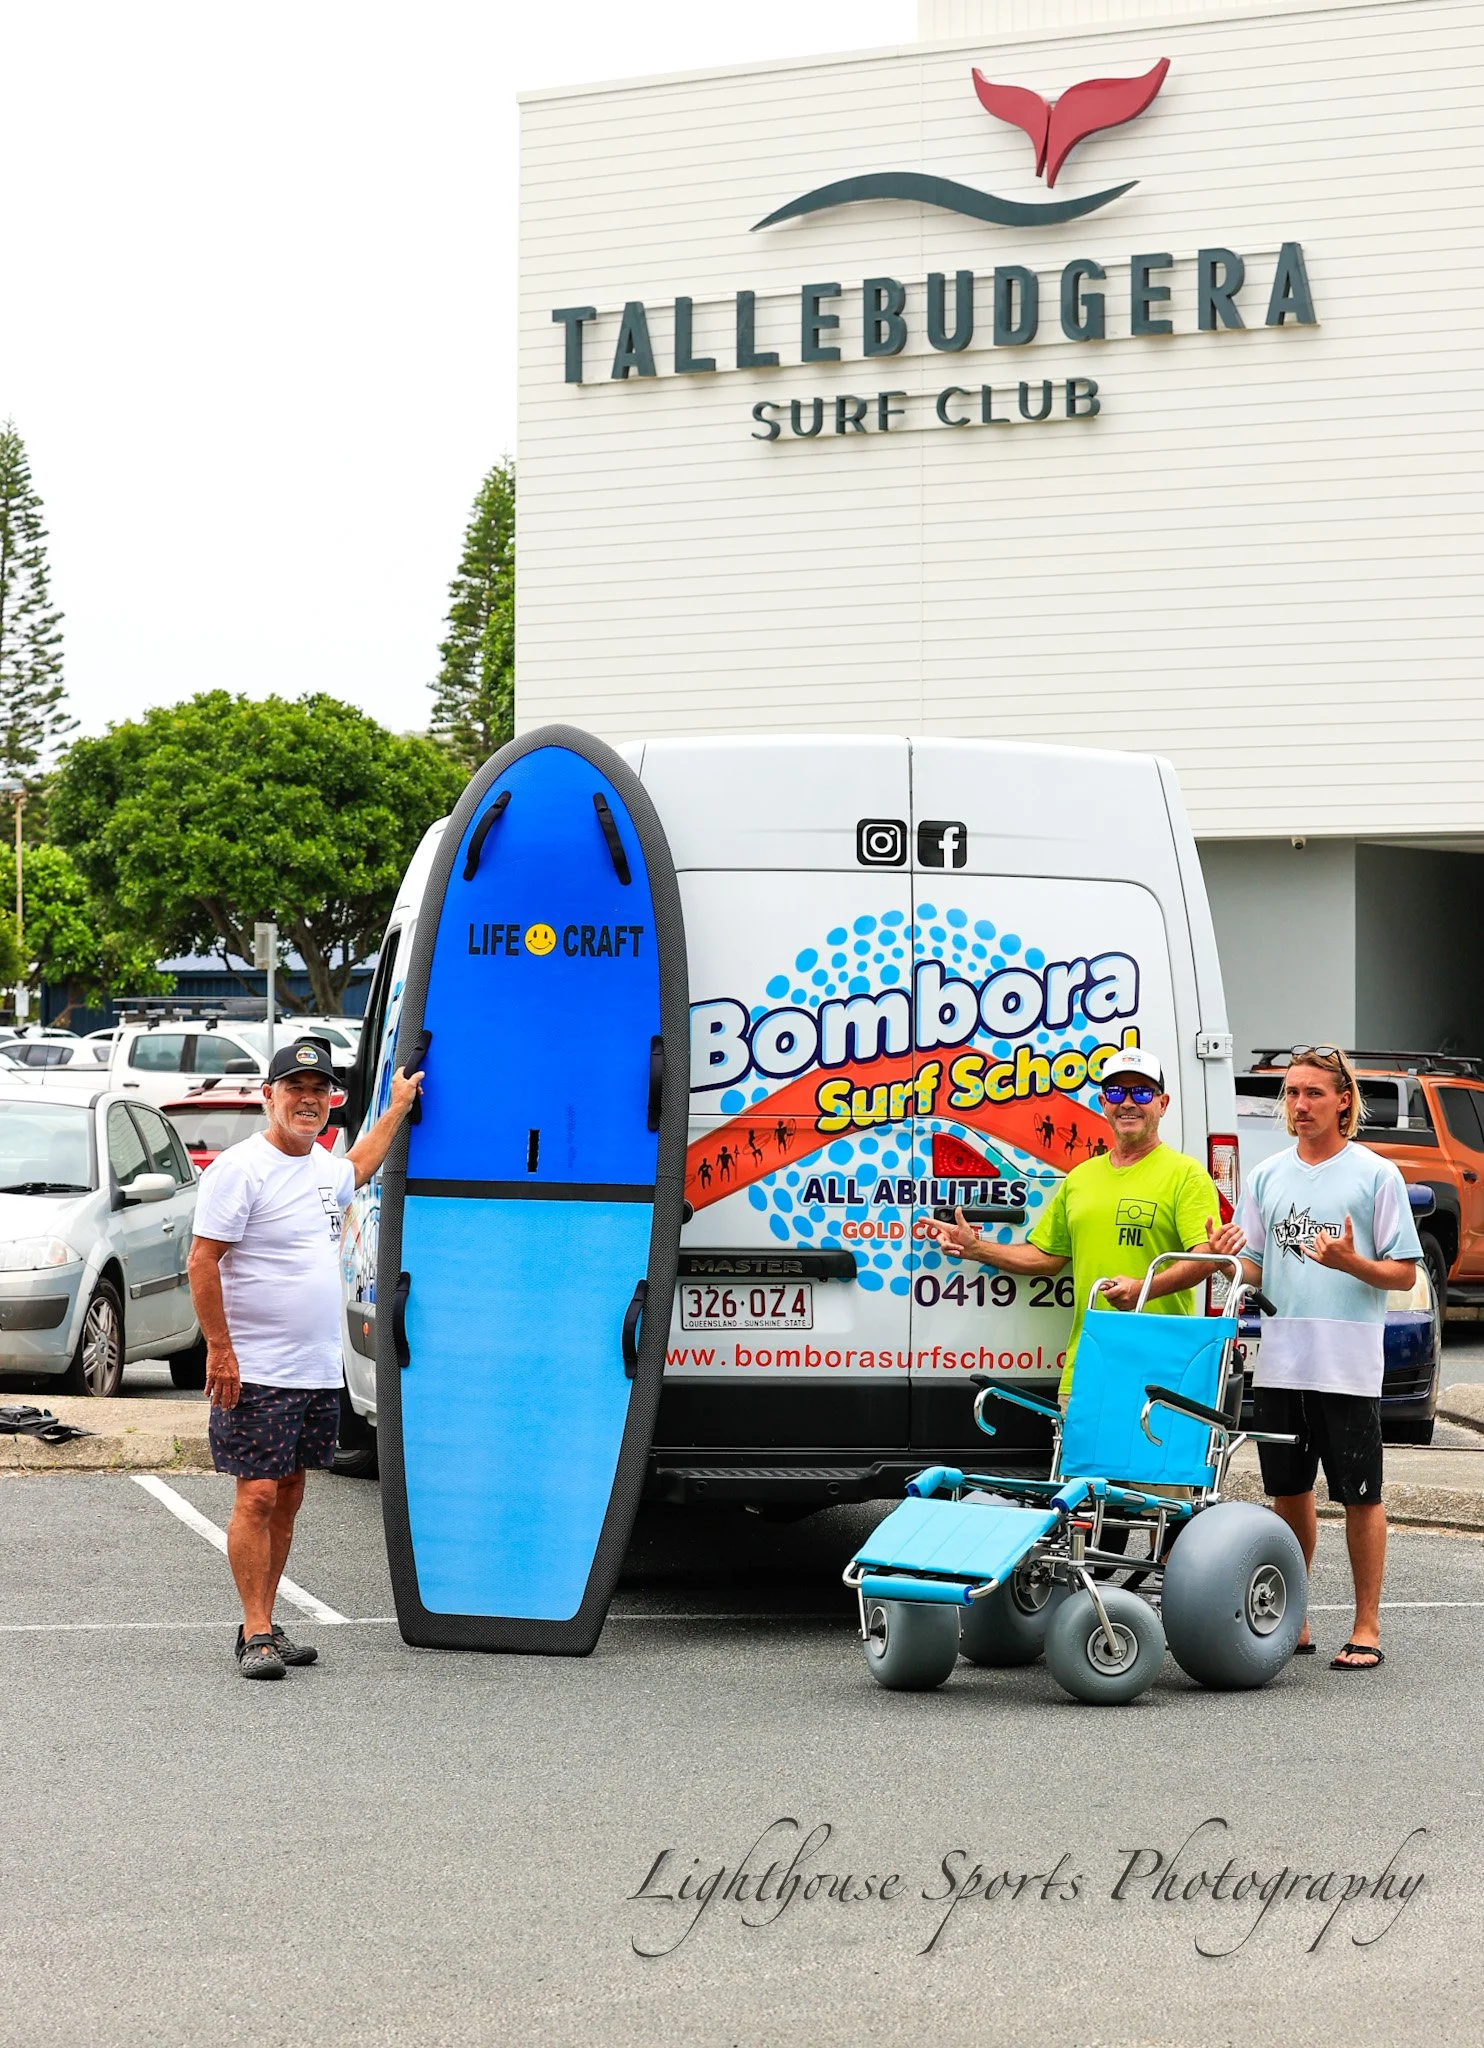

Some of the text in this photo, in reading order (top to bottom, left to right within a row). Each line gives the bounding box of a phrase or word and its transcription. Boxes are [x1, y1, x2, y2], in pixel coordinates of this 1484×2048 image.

[551, 241, 1320, 385] TALLEBUDGERA
[750, 376, 1101, 441] SURF CLUB
[468, 922, 645, 957] LIFE CRAFT
[690, 950, 1140, 1093] Bombora
[813, 1060, 943, 1133] Surf
[802, 1177, 1028, 1207] ALL ABILITIES
[842, 1221, 905, 1240] GOLD
[1118, 1227, 1144, 1247] FNL
[690, 1259, 803, 1274] MASTER
[914, 1274, 1074, 1308] 0419 26
[688, 1320, 738, 1328] QUEENSLAND
[744, 1319, 781, 1327] SUNSHINE
[784, 1319, 806, 1327] STATE
